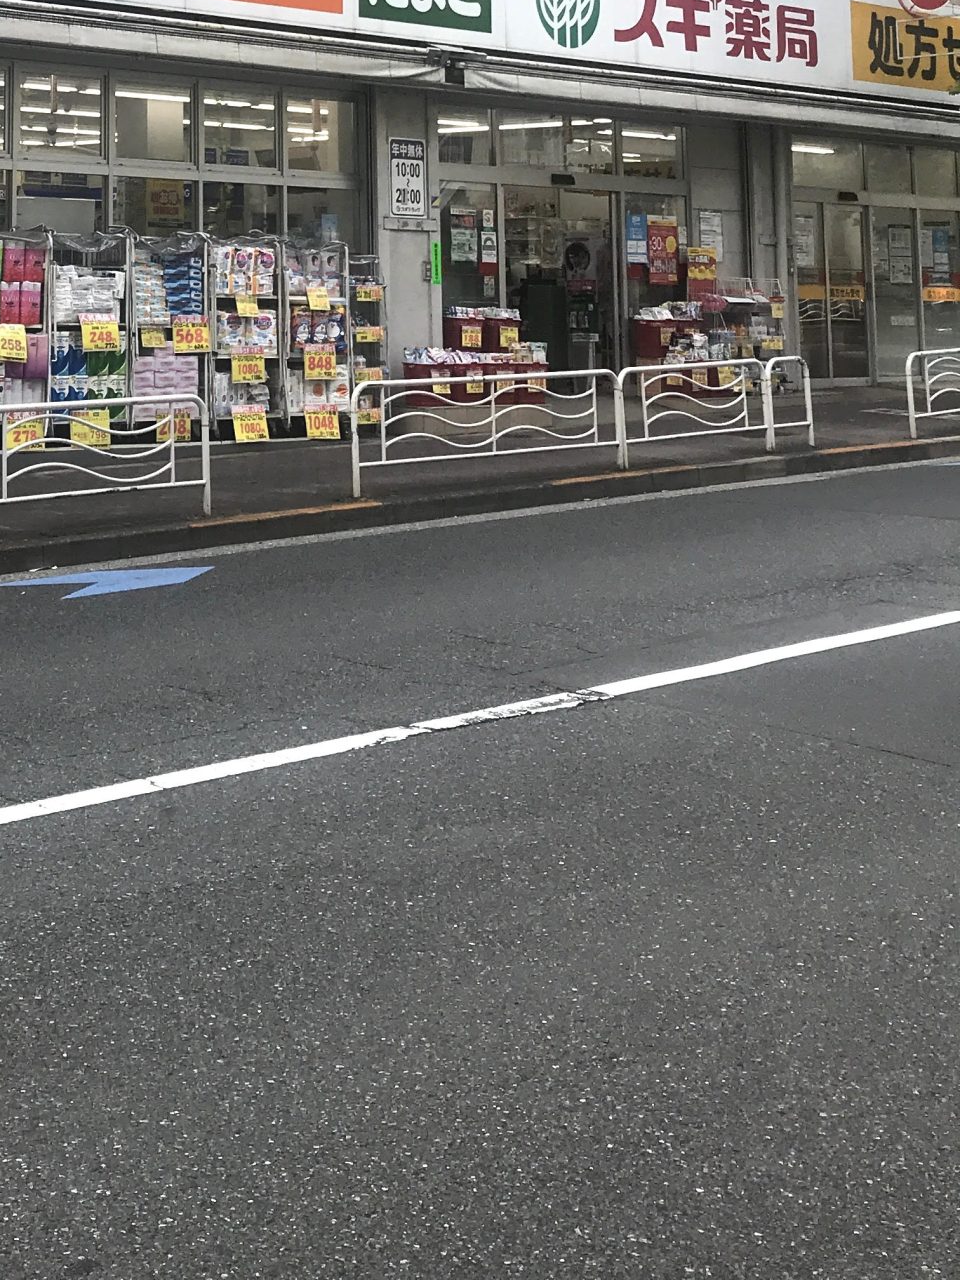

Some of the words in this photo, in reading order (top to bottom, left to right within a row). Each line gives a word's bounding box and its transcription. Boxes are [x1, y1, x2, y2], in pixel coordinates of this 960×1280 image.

[392, 143, 423, 158] 年中無休
[395, 162, 420, 178] 10:00
